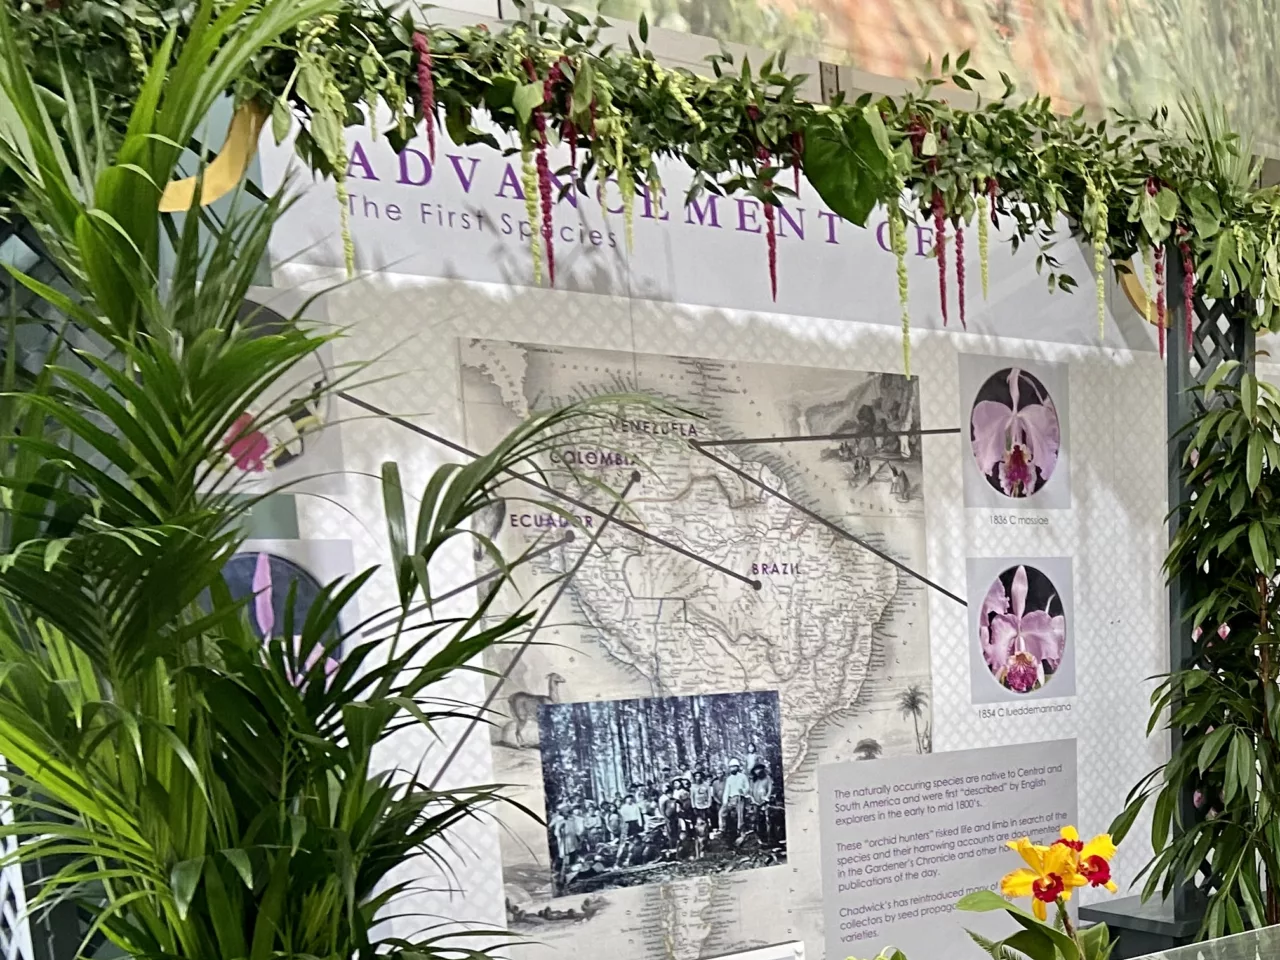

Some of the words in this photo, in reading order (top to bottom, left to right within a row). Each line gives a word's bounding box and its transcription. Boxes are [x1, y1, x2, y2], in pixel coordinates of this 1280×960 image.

[347, 193, 402, 222] The
[420, 202, 484, 232] First
[610, 419, 698, 437] VENEZUELA
[510, 513, 594, 529] ECUADOR
[990, 515, 1008, 525] 1836
[1008, 515, 1017, 525] C
[751, 562, 802, 576] BRAZIL
[978, 709, 996, 719] 1854
[997, 707, 1005, 717] C
[834, 789, 851, 799] The
[853, 784, 891, 797] naturally
[933, 776, 964, 789] species
[965, 775, 979, 784] are
[981, 771, 1006, 782] native
[1008, 770, 1016, 779] to
[1017, 765, 1046, 777] Central
[1047, 764, 1063, 774] and
[834, 802, 861, 813] South
[863, 796, 901, 809] America
[902, 793, 920, 804] and
[921, 791, 943, 801] were
[945, 788, 958, 798] first
[1009, 782, 1019, 792] by
[1021, 778, 1047, 790] English
[835, 813, 876, 826] explorers
[877, 811, 886, 820] in
[887, 809, 902, 819] the
[904, 806, 925, 817] early
[927, 805, 936, 814] to
[937, 802, 954, 813] mid
[836, 842, 862, 852] These
[935, 826, 959, 838] risked
[960, 824, 972, 834] life
[974, 822, 991, 832] and
[992, 820, 1009, 830] limb
[1010, 818, 1018, 827] in
[1018, 814, 1044, 826] search
[1045, 812, 1054, 822] of
[1055, 811, 1068, 820] the
[836, 853, 871, 867] species
[872, 850, 891, 860] and
[892, 847, 912, 857] their
[913, 840, 955, 854] harrowing
[957, 834, 995, 847] accounts
[996, 832, 1009, 841] are
[1011, 824, 1060, 839] documented
[837, 869, 846, 879] in
[848, 867, 863, 877] the
[864, 859, 914, 874] Gardener's
[915, 852, 956, 866] Chronicle
[957, 849, 975, 860] and
[976, 846, 997, 857] other
[838, 875, 892, 892] publications
[893, 873, 904, 883] of
[905, 871, 919, 880] the
[921, 868, 940, 879] day.
[839, 900, 891, 918] Chadwick's
[893, 897, 909, 908] has
[910, 888, 964, 905] reintroduced
[966, 885, 989, 895] many
[990, 881, 999, 891] of
[839, 916, 883, 931] collectors
[884, 913, 896, 924] by
[897, 909, 919, 920] seed
[920, 903, 957, 917] propaga
[840, 928, 880, 944] varieties.
